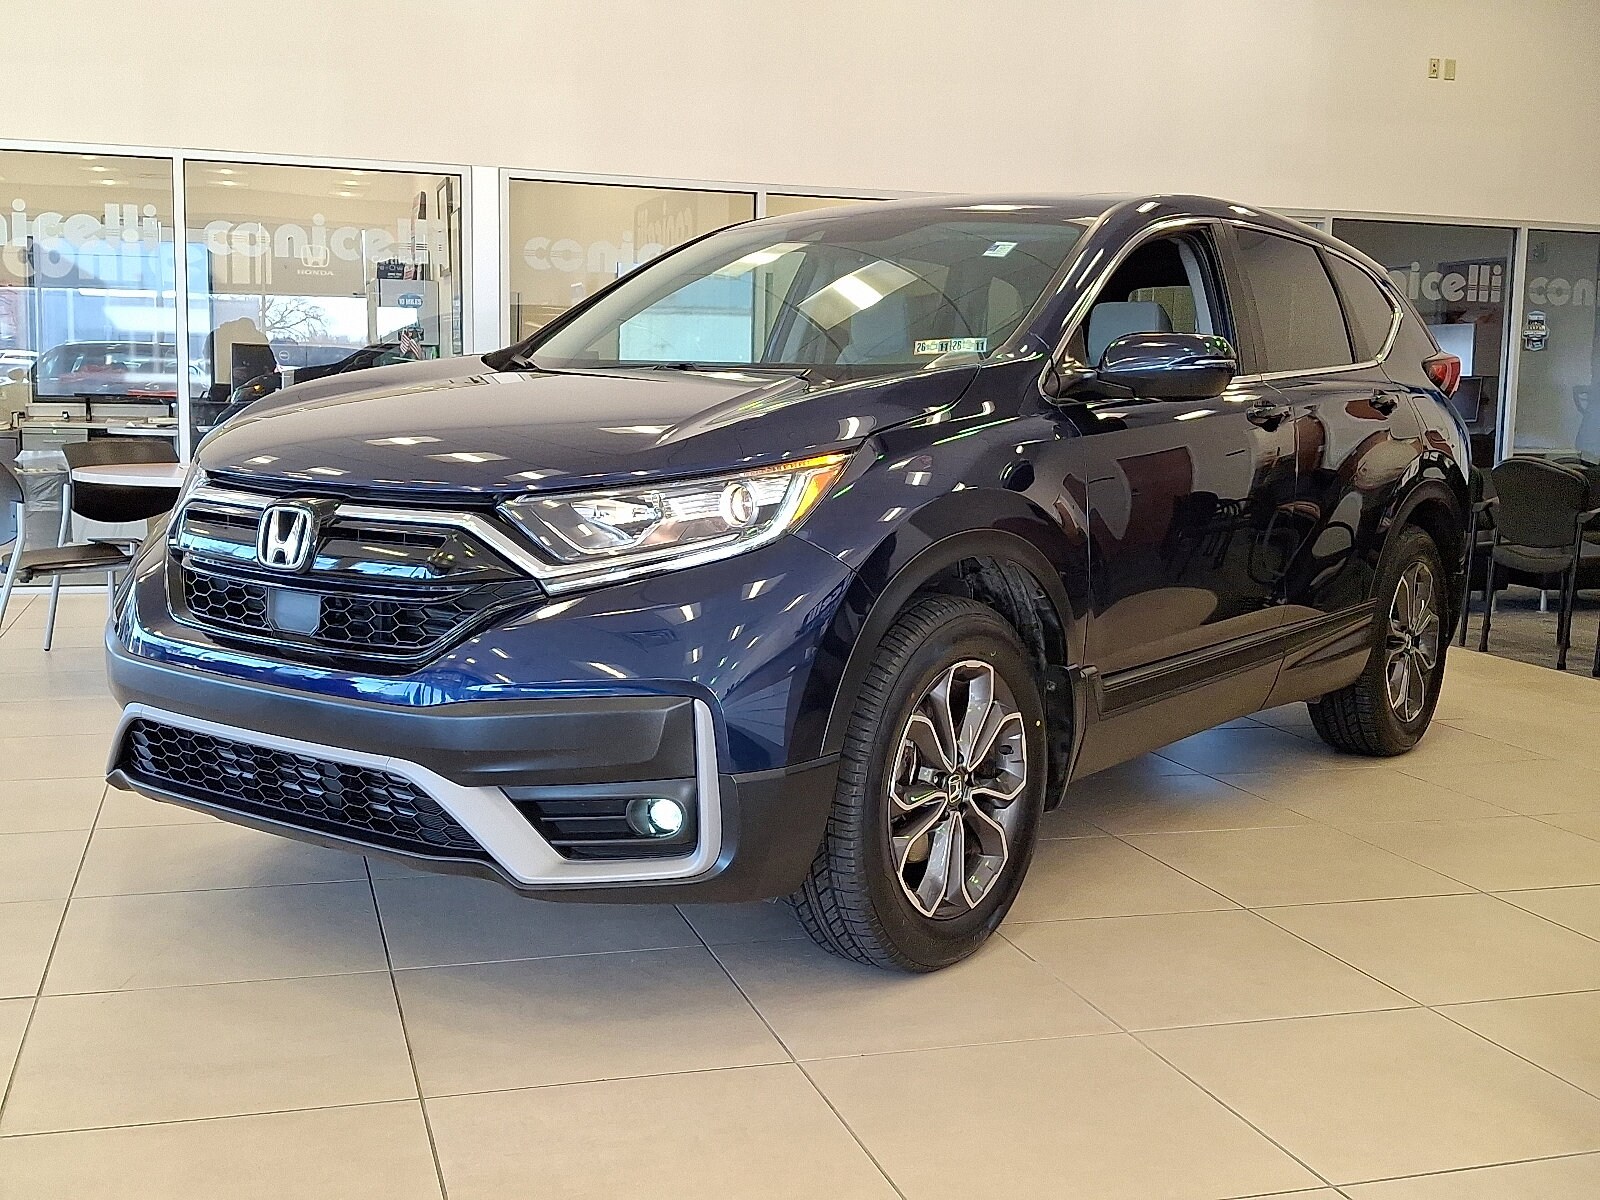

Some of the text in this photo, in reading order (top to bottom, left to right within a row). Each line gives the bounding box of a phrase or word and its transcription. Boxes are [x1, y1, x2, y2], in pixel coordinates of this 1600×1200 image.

[0, 198, 158, 252] icelli
[1528, 276, 1600, 306] con
[917, 342, 949, 352] 26 11
[976, 341, 985, 351] 11
